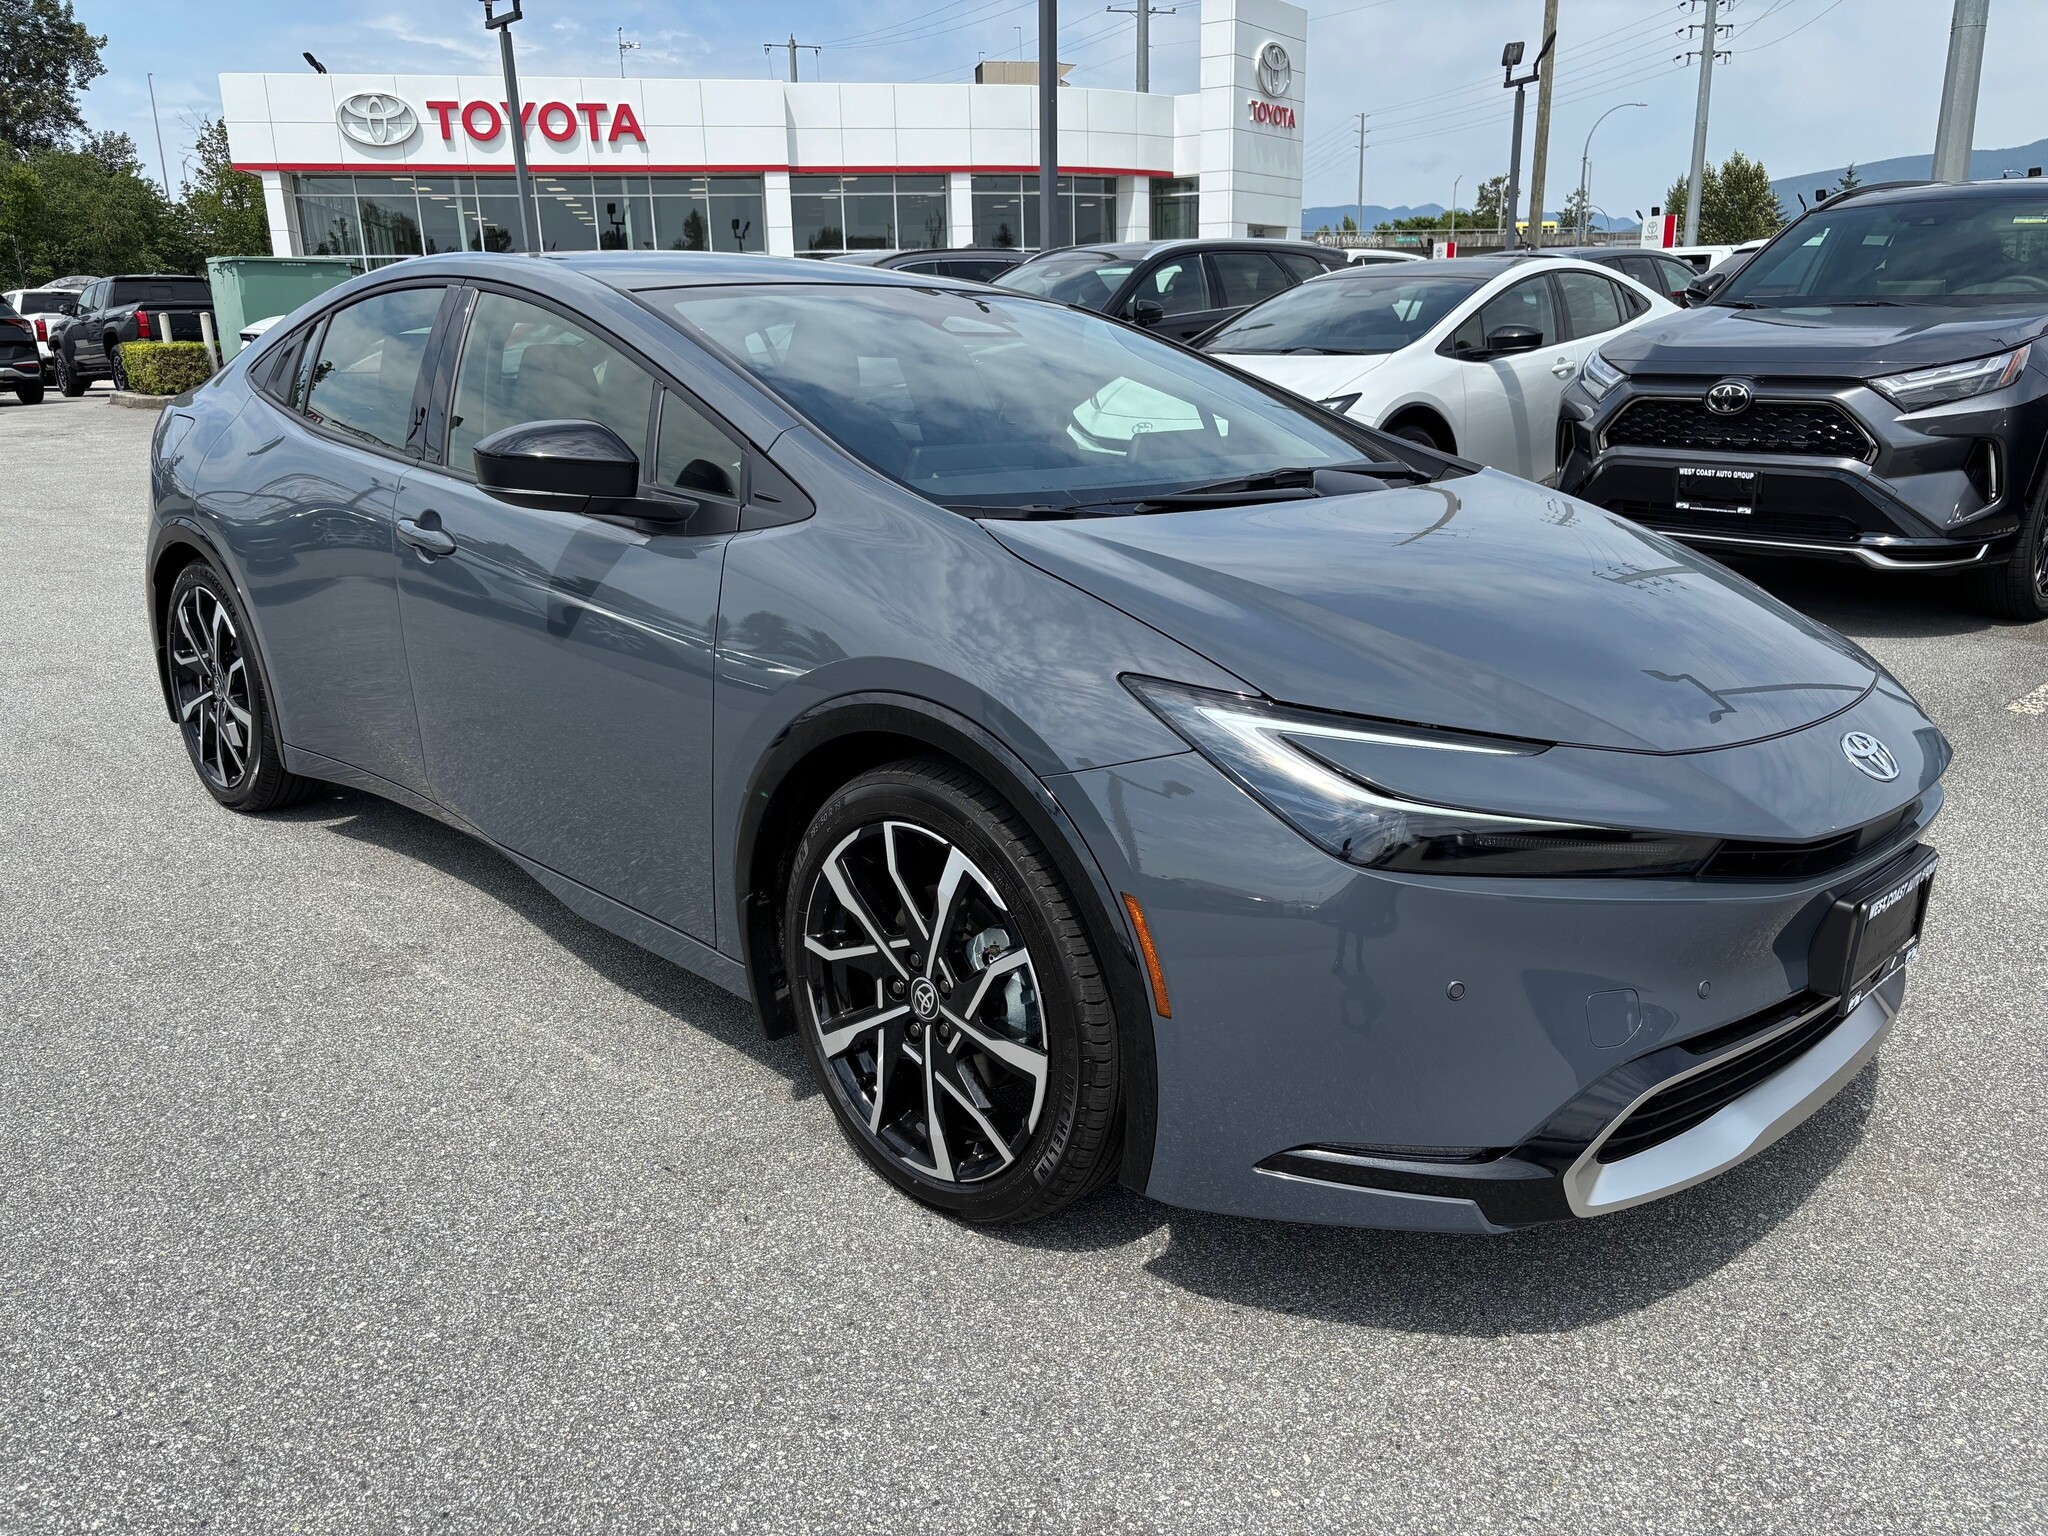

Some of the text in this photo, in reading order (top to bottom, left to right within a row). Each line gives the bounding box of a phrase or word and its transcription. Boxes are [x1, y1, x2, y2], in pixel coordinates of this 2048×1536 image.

[426, 100, 646, 142] TOYOTA
[1251, 100, 1296, 128] TOYOTA
[1696, 469, 1715, 477] COAST
[1716, 470, 1732, 478] AUTO
[1733, 471, 1754, 480] GROUP
